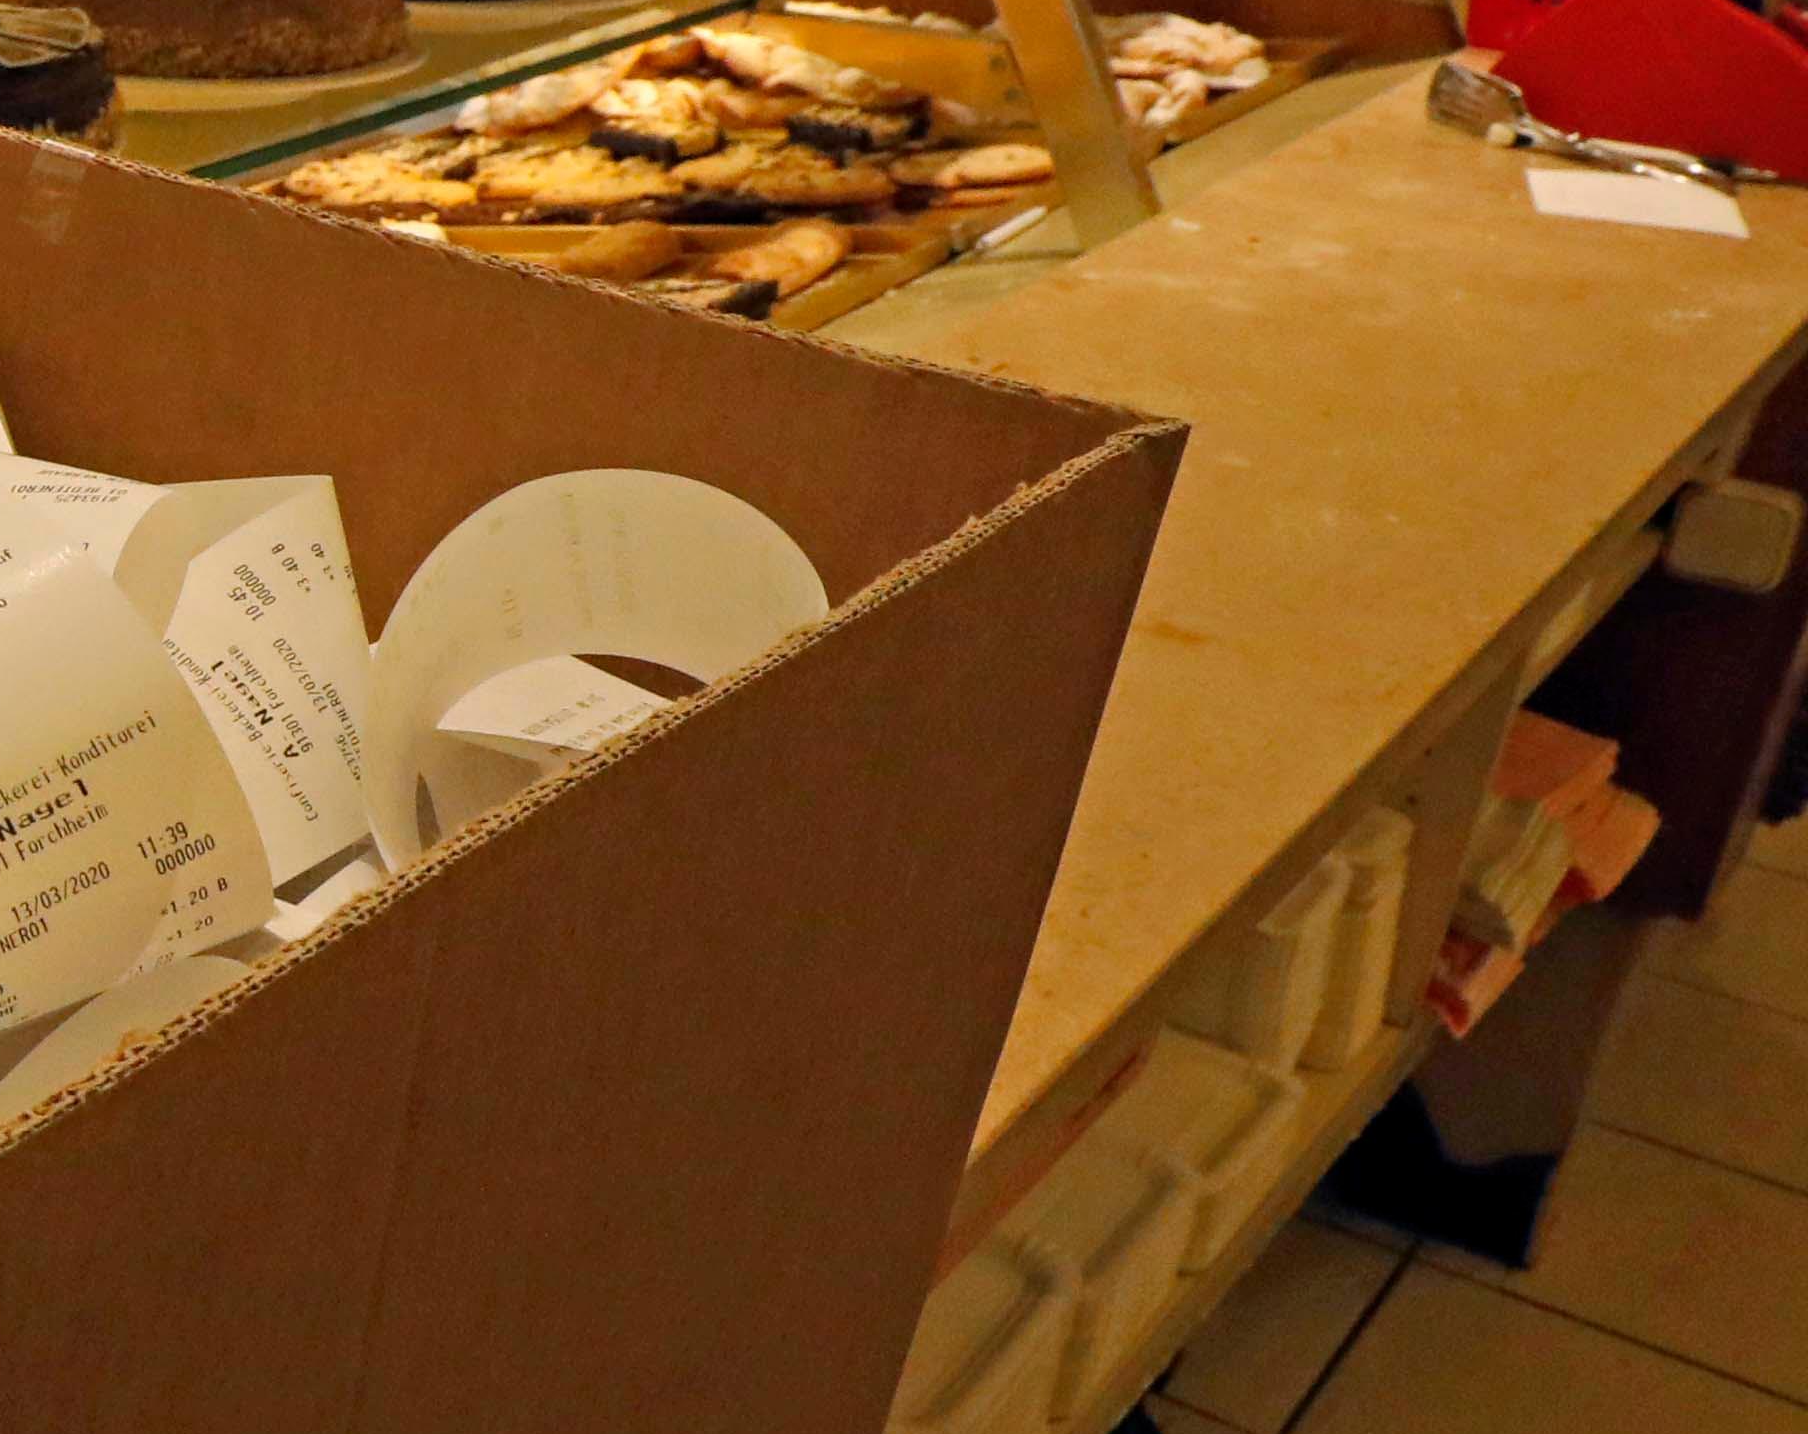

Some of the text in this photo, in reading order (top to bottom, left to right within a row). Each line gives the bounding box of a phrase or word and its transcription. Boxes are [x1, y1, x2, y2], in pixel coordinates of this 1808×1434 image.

[14, 801, 112, 863] Forchheim
[155, 833, 216, 878] 000000
[10, 861, 113, 926] 13/03/2020
[135, 822, 190, 861] 11:39
